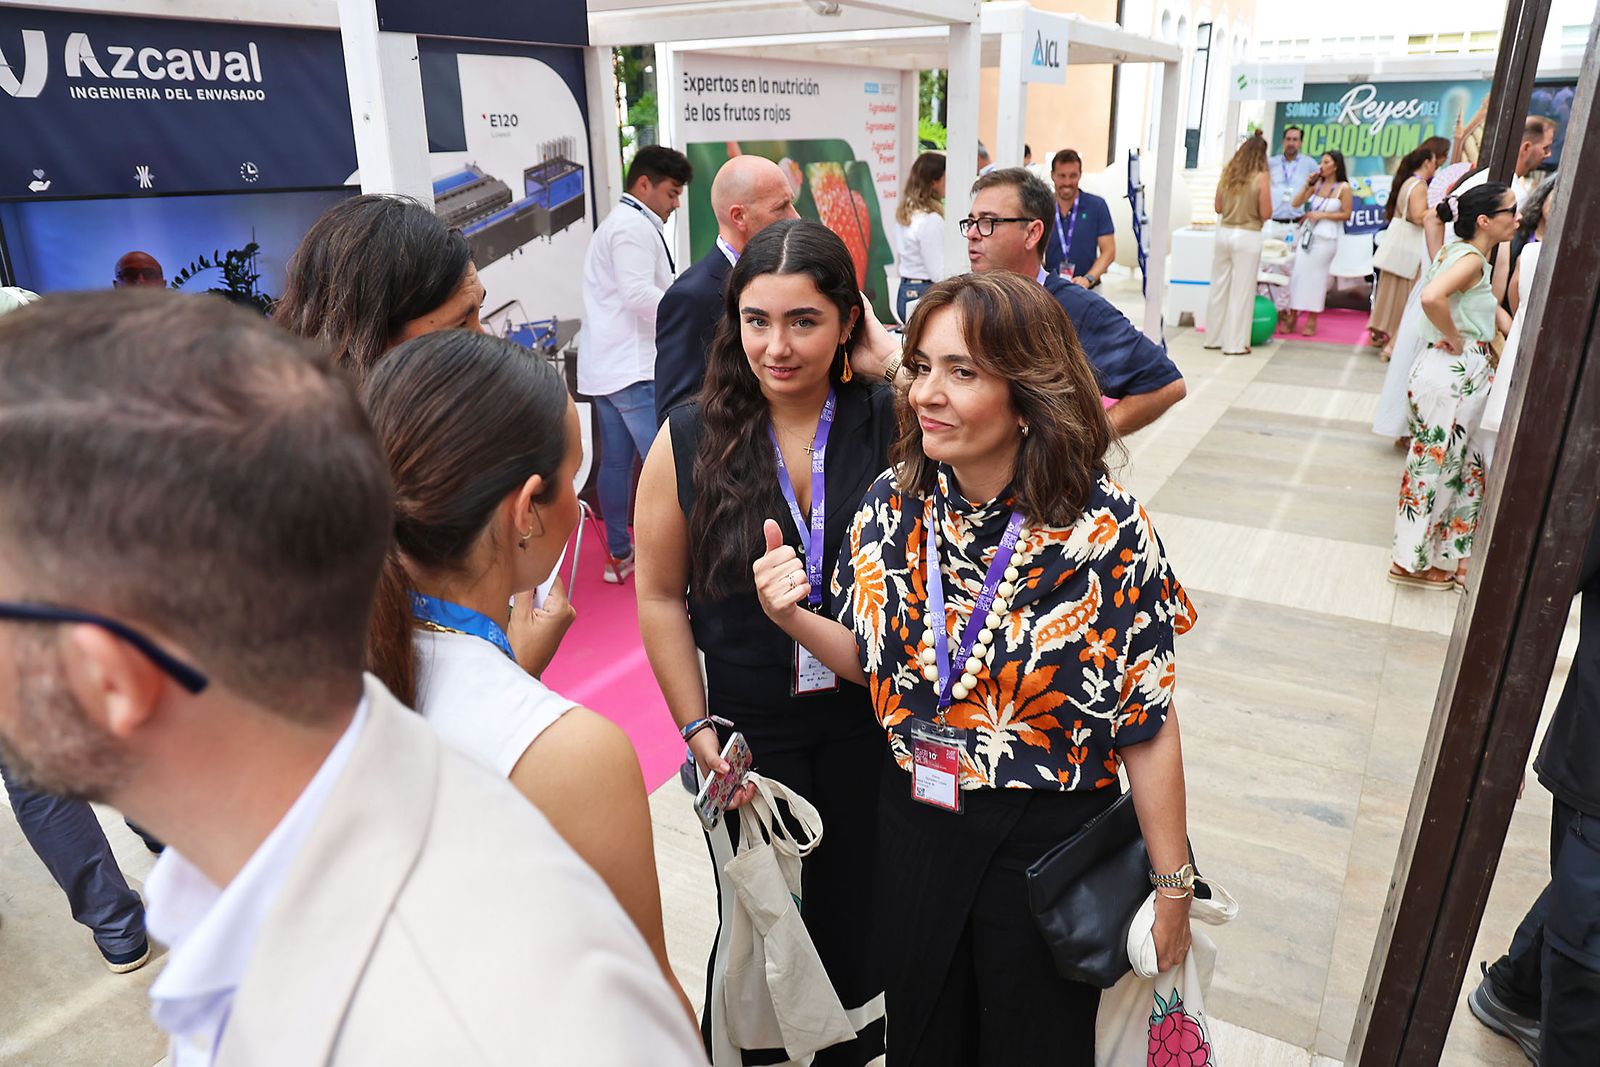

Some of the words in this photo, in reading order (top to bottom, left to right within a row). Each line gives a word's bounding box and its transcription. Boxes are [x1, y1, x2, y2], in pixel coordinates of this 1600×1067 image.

[64, 32, 263, 83] Azcaval
[69, 86, 161, 100] INGENIERIA
[164, 87, 192, 101] DEL
[196, 88, 266, 102] ENVASADO
[741, 78, 757, 93] en
[758, 75, 769, 94] la
[772, 77, 820, 96] nutrición
[490, 113, 519, 128] E120
[684, 102, 698, 121] de
[702, 102, 721, 122] los
[724, 102, 761, 122] frutos
[763, 103, 791, 125] rojos
[1285, 102, 1320, 117] SOMOS
[1323, 101, 1342, 117] LOS
[1338, 83, 1425, 135] Reyes
[1420, 100, 1441, 117] DEL
[1283, 122, 1436, 158] ICROBIOM
